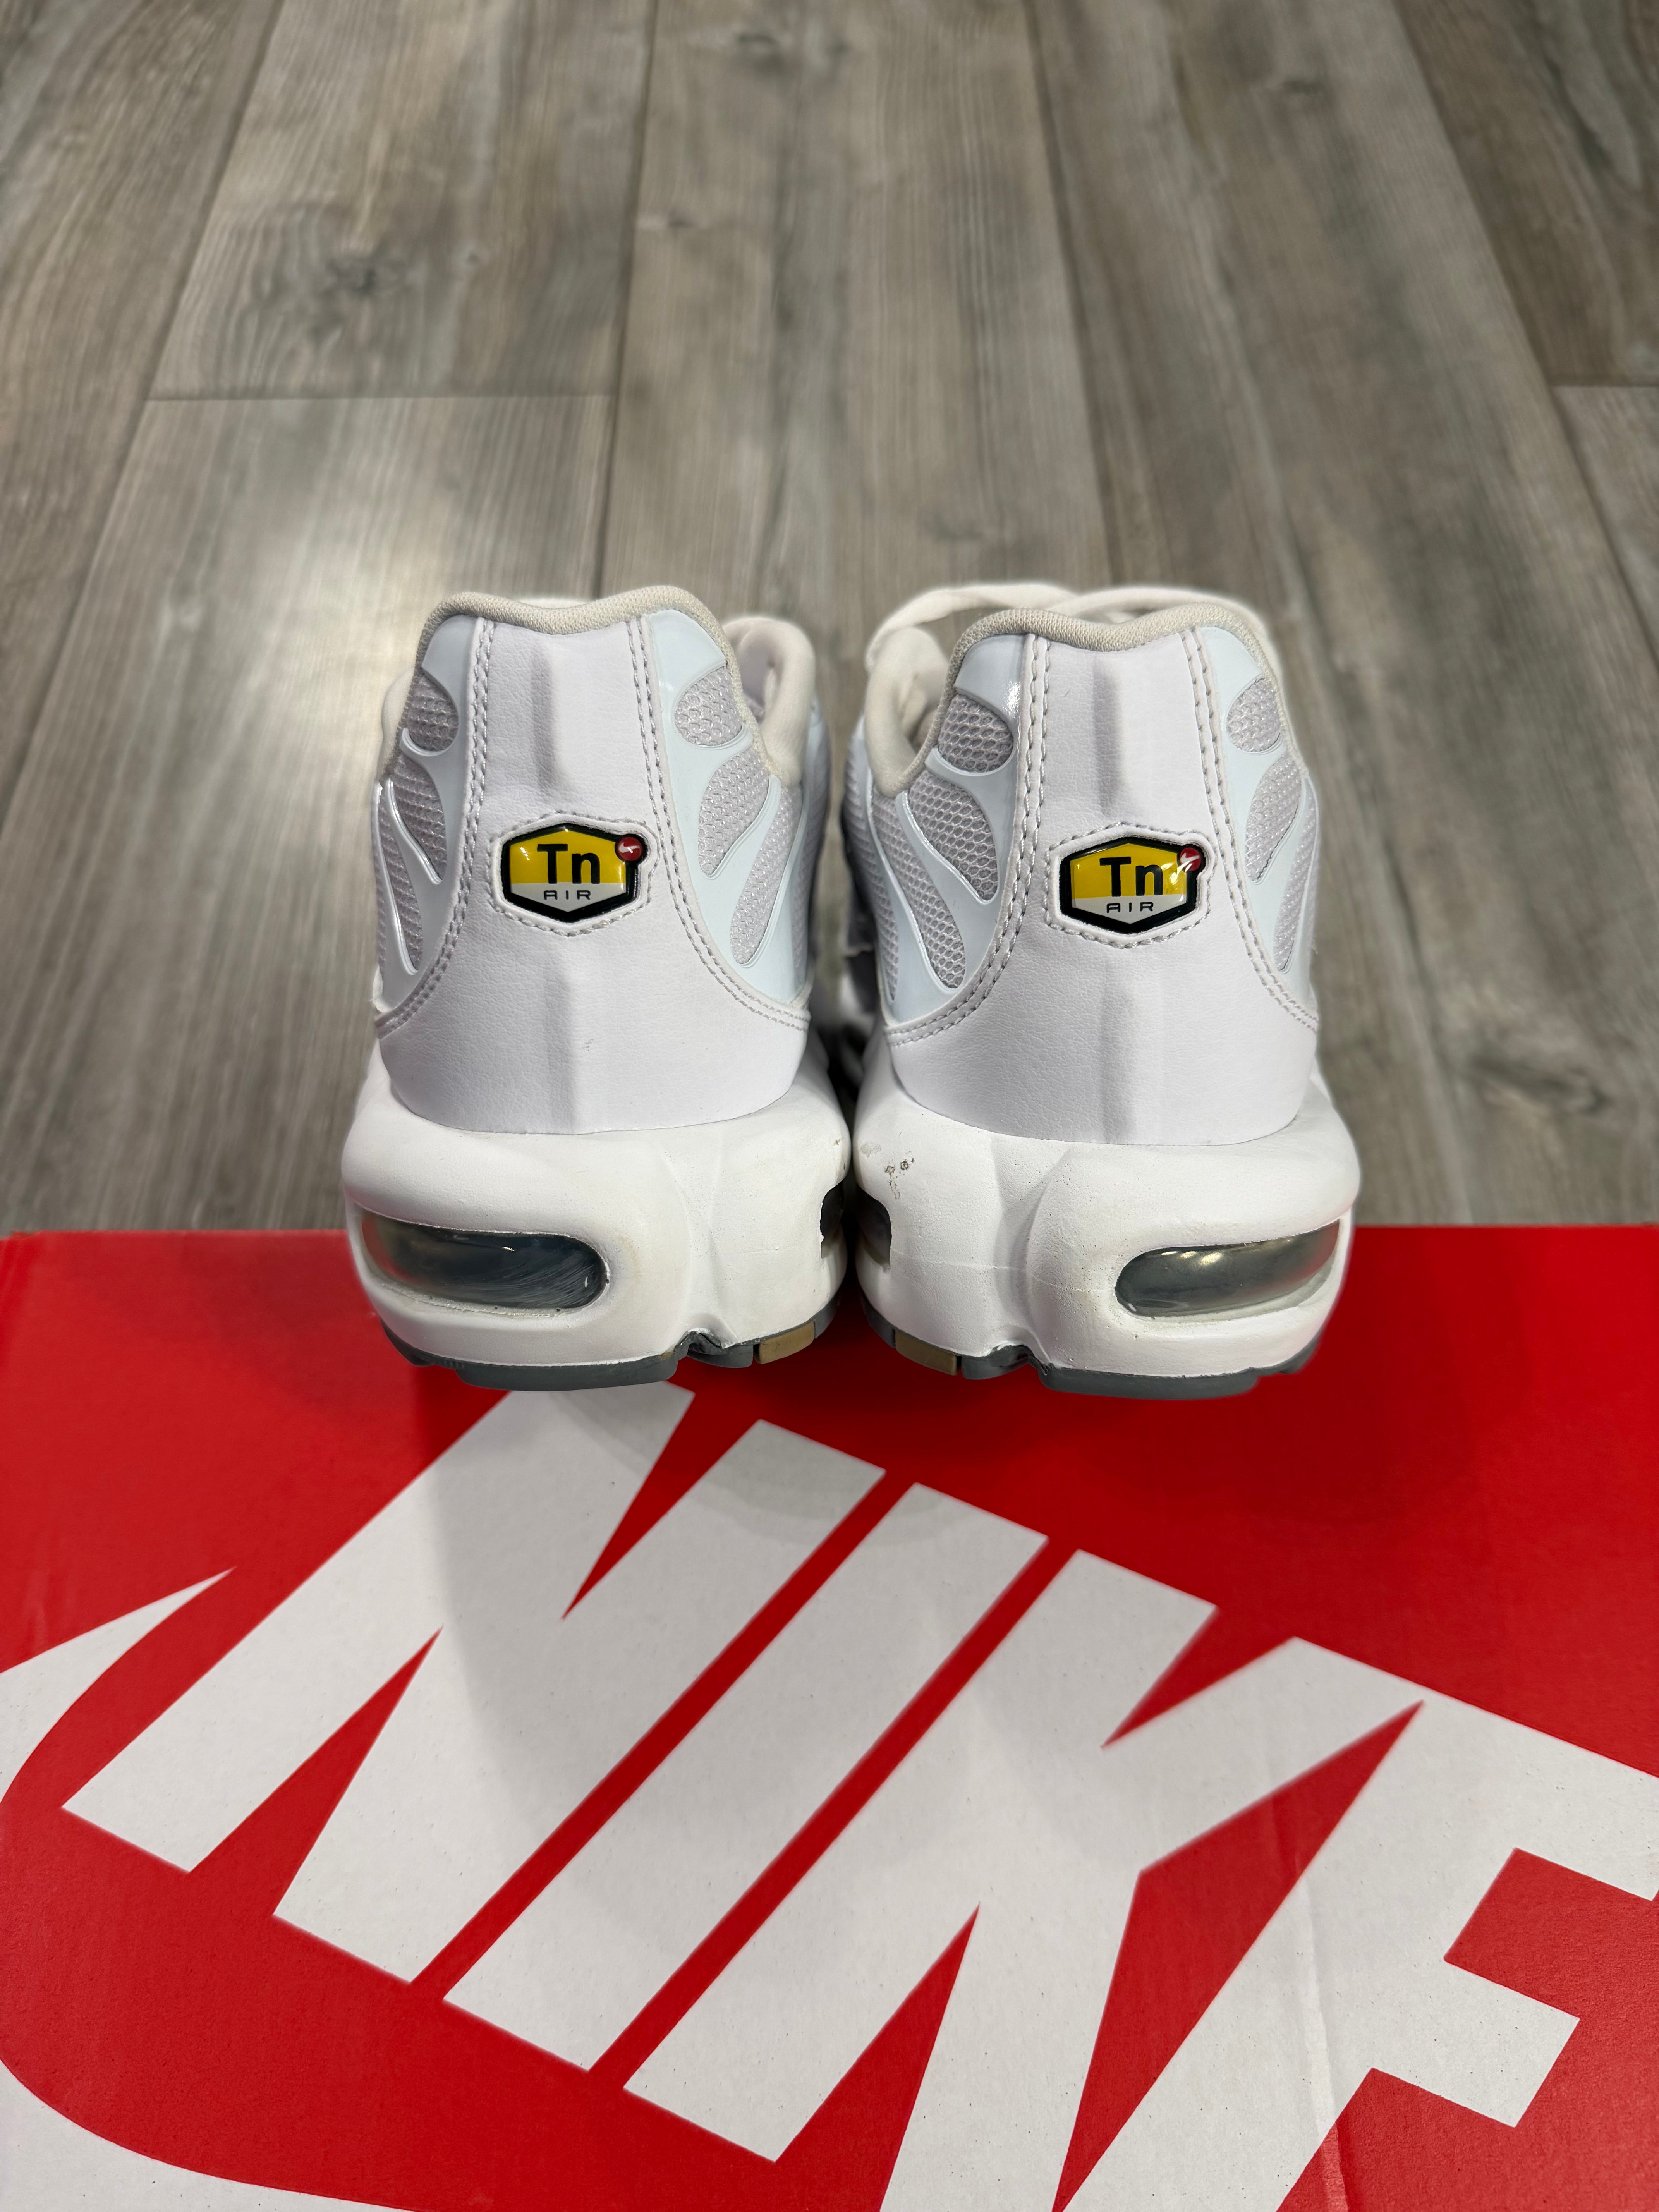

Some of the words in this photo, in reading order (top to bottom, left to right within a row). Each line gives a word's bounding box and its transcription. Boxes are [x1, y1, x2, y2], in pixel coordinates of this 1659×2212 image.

[537, 843, 600, 884] Tn
[1099, 856, 1163, 897] Tn
[544, 890, 591, 900] AIR
[1106, 902, 1153, 914] AIR
